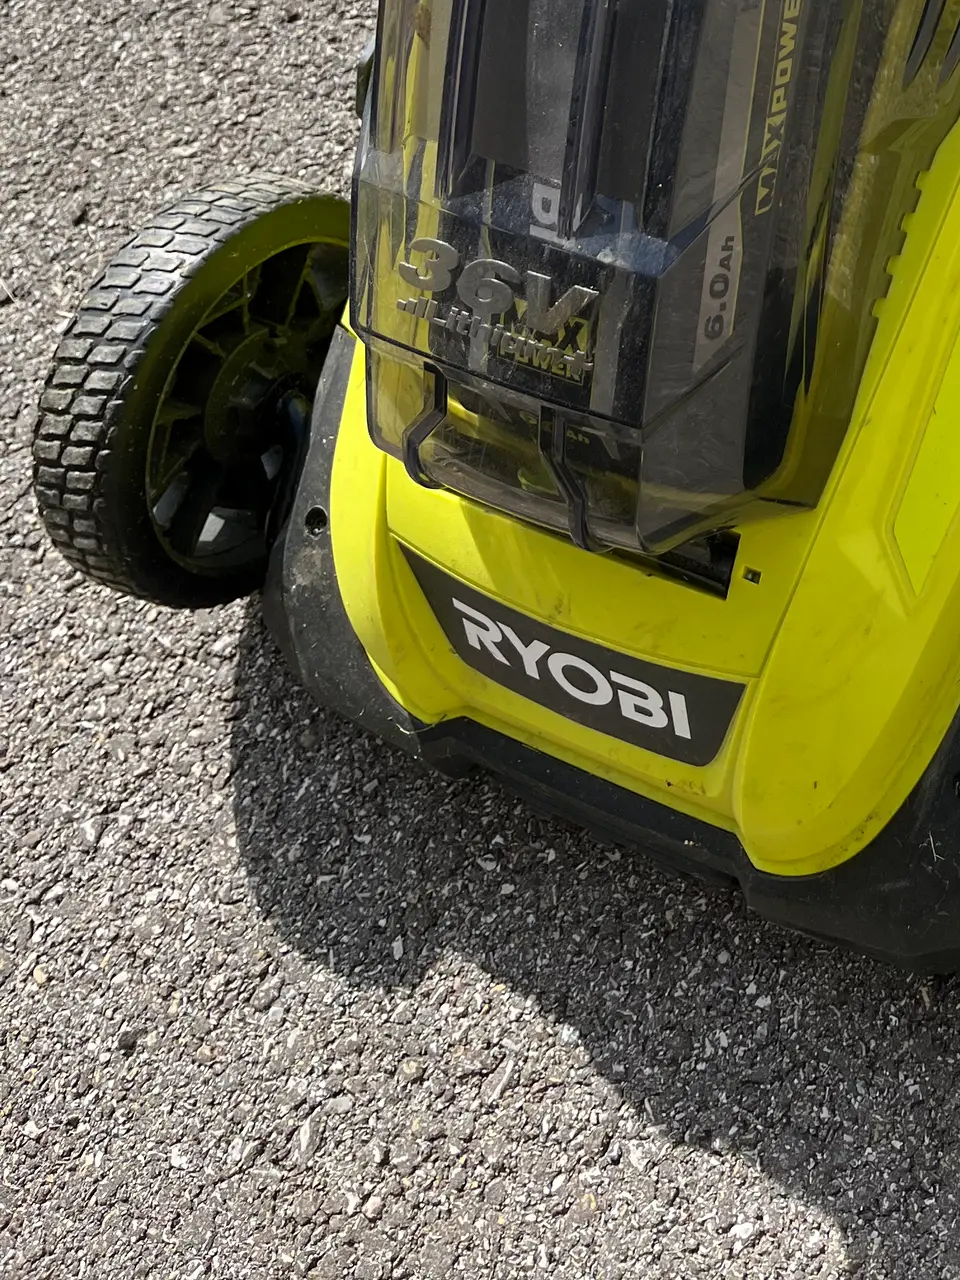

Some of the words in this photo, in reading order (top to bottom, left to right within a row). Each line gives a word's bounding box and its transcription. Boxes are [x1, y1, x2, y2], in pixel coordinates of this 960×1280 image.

[398, 236, 600, 334] 36V
[703, 234, 735, 341] 6.0Ah
[452, 597, 692, 740] RYOBI
